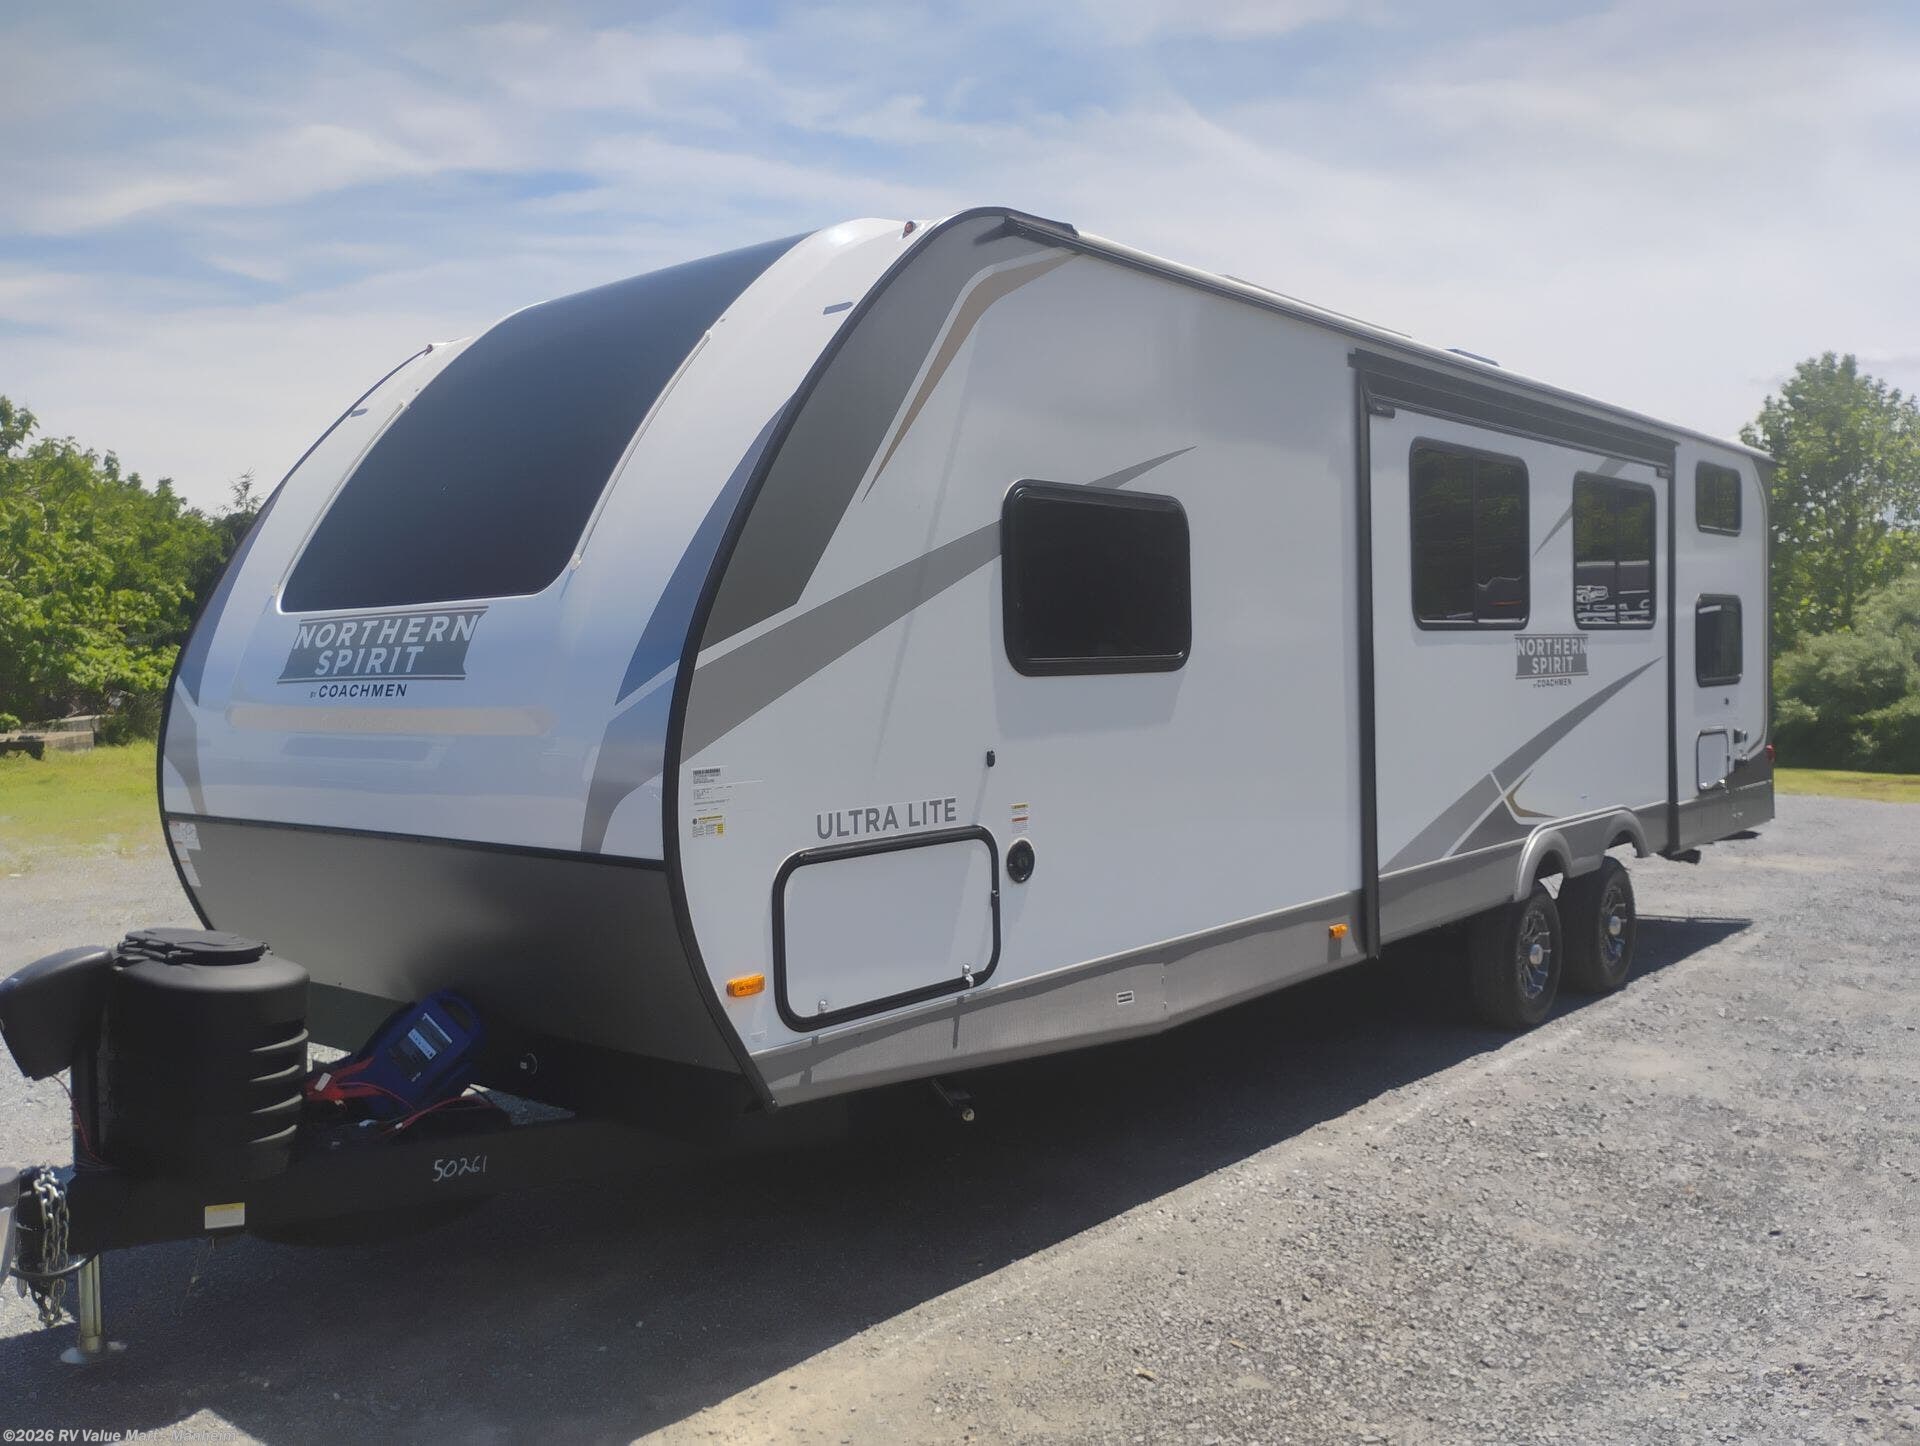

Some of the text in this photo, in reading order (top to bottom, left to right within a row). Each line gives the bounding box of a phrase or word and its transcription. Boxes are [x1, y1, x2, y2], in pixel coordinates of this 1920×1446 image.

[293, 614, 479, 650] NORTHERN
[314, 645, 425, 676] SPIRIT
[1516, 638, 1587, 656] NORTHERN
[1532, 656, 1574, 674] SPIRIT
[318, 683, 407, 699] COACHMEN
[816, 798, 957, 840] ULTRA LITE
[431, 1155, 488, 1183] 50261
